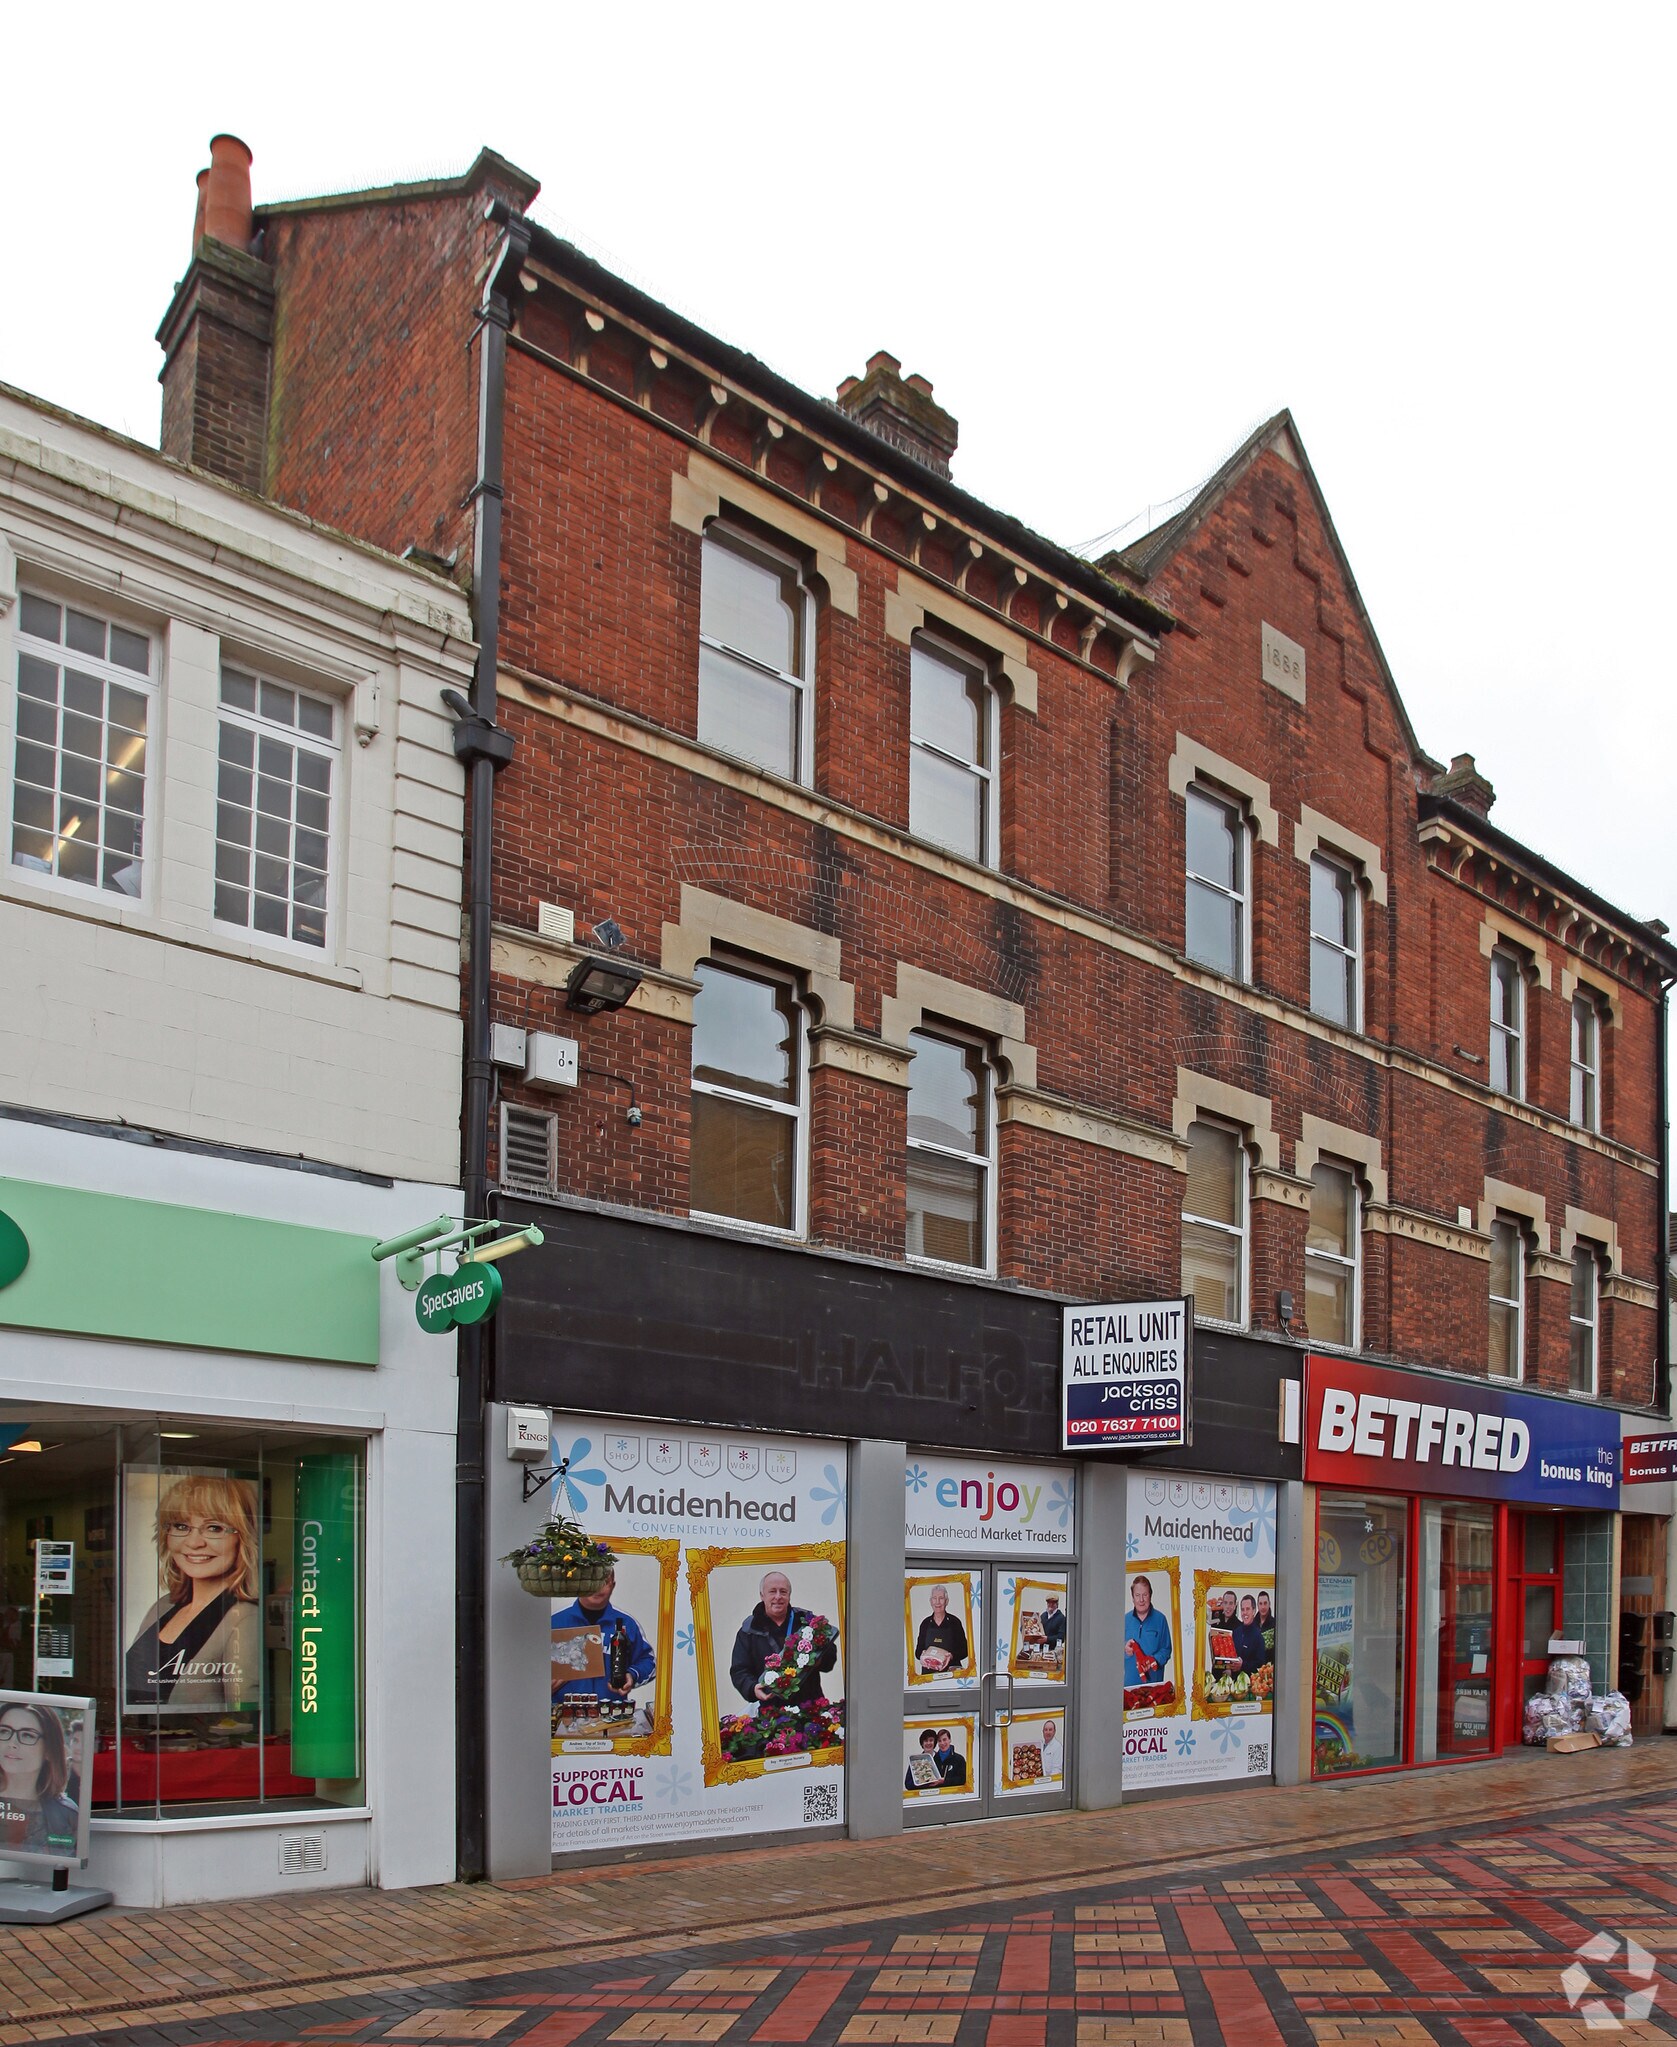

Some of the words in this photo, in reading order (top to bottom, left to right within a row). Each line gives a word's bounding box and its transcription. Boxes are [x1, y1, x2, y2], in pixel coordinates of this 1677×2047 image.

[422, 1280, 485, 1318] Specsavers
[1071, 1315, 1134, 1347] RETAIL
[1139, 1310, 1181, 1342] UNIT
[1073, 1354, 1099, 1377] ALL
[1103, 1349, 1178, 1375] ENQUIRIES
[1101, 1382, 1178, 1403] jackson
[1129, 1397, 1178, 1411] criss
[1070, 1421, 1098, 1433] 020
[1102, 1419, 1137, 1431] 7637
[1142, 1417, 1178, 1430] 7100
[1318, 1387, 1530, 1473] BETFRED
[518, 1430, 548, 1442] KINGS
[1101, 1432, 1178, 1442] www.jacksoncriss.co.uk
[609, 1451, 636, 1462] SHOP
[655, 1455, 673, 1464] EAT
[693, 1458, 717, 1468] PLAY
[1597, 1447, 1613, 1465] the
[730, 1461, 757, 1471] WORK
[771, 1464, 791, 1474] LIVE
[1540, 1459, 1582, 1481] bonus
[1586, 1465, 1613, 1489] king
[1629, 1467, 1667, 1477] bonus
[604, 1483, 796, 1523] Maidenhead
[936, 1471, 1042, 1524] enjoy
[632, 1521, 727, 1537] CONVENIENTLY
[733, 1526, 772, 1538] YOURS
[905, 1523, 978, 1539] Maidenhead
[981, 1527, 1022, 1541] Market
[1025, 1529, 1067, 1543] Traders
[1144, 1515, 1254, 1543] Maidenhead
[1160, 1543, 1216, 1553] CONVENIENTLY
[1217, 1546, 1240, 1554] YOURS
[302, 1520, 323, 1618] Contact
[1320, 1607, 1336, 1621] FREE
[1337, 1604, 1352, 1618] PLAY
[1319, 1619, 1352, 1636] MACHINES
[301, 1627, 323, 1713] Lenses
[1325, 1657, 1342, 1672] WIN
[1318, 1665, 1342, 1683] FREE
[1317, 1675, 1339, 1693] PLAY
[1123, 1737, 1168, 1756] OCAL
[1142, 1754, 1168, 1762] TRADERS
[552, 1767, 644, 1783] SUPPORTING
[552, 1780, 644, 1807] LOCAL
[6, 1812, 26, 1821] £69
[552, 1807, 595, 1818] MARKET
[598, 1803, 643, 1814] TRADERS
[553, 1819, 583, 1829] TRADING
[583, 1818, 602, 1827] EVERY
[623, 1815, 642, 1823] THIRD
[643, 1813, 657, 1821] AND
[657, 1812, 674, 1820] FIFTH
[675, 1810, 706, 1819] SATURDAY
[706, 1808, 716, 1816] ON
[729, 1806, 744, 1814] HIGH
[744, 1804, 764, 1812] STREET
[552, 1831, 564, 1839] For
[566, 1828, 590, 1838] details
[601, 1826, 610, 1834] all
[610, 1825, 639, 1834] markets
[640, 1823, 654, 1831] visit
[655, 1815, 750, 1830] www.enjoymaidenhead.com
